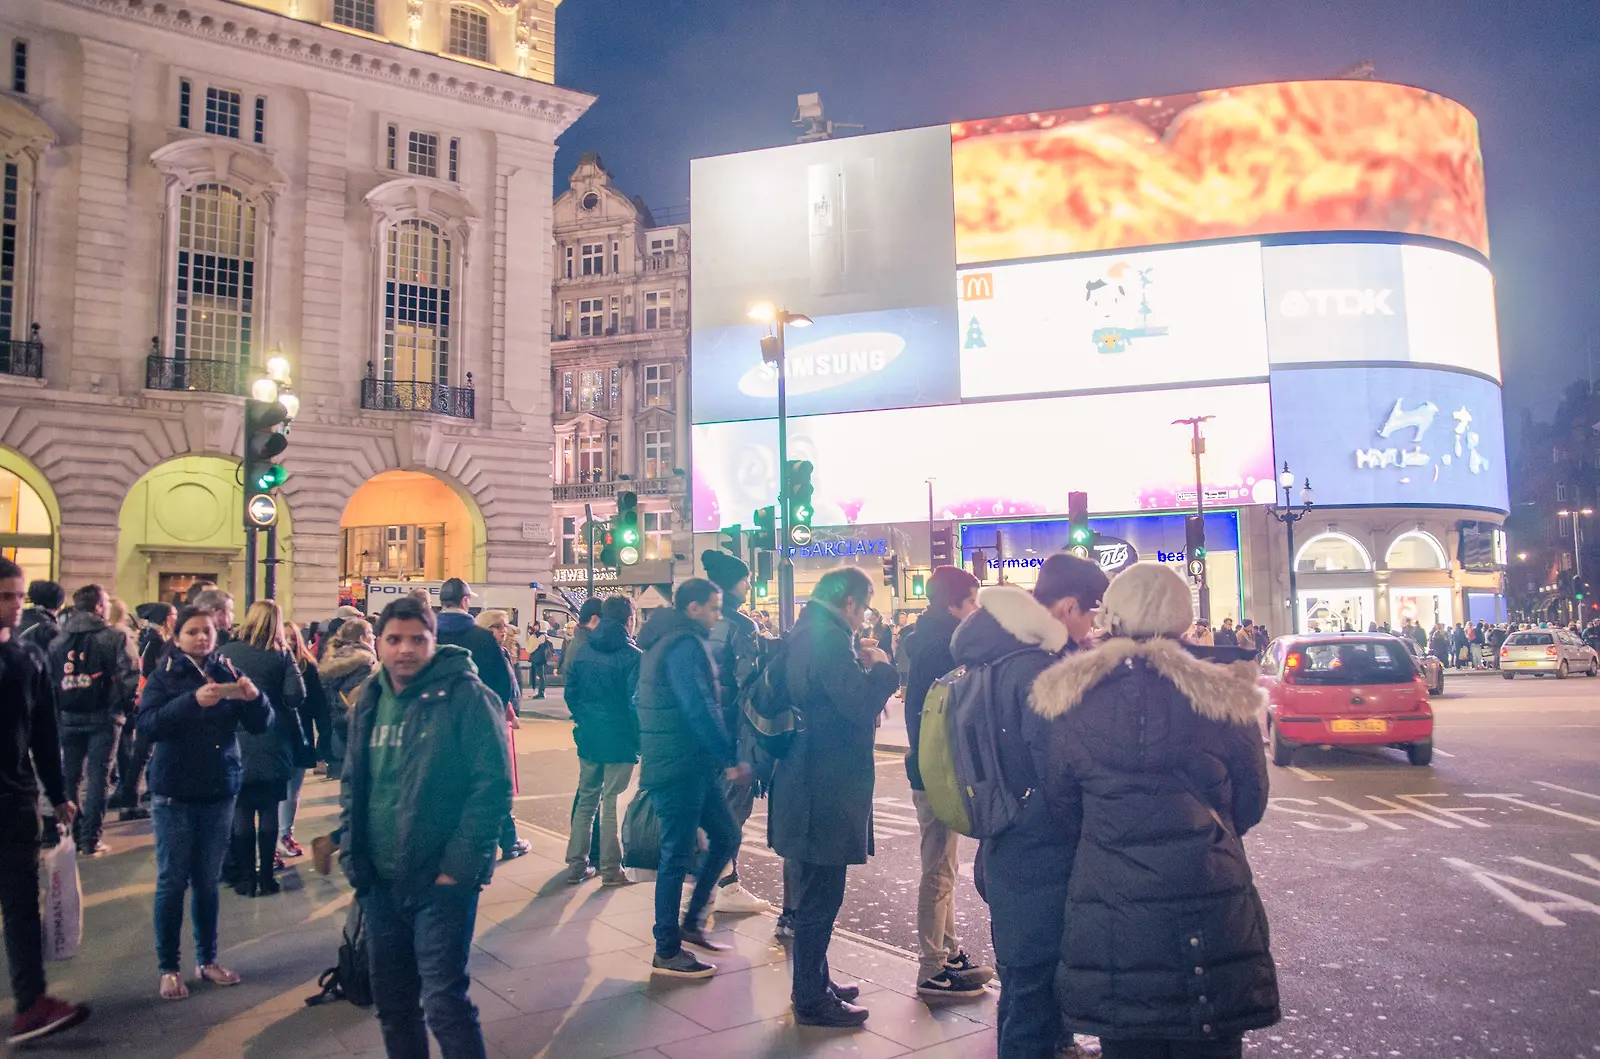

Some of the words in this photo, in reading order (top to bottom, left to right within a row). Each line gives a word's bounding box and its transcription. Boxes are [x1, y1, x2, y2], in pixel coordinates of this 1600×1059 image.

[1305, 288, 1396, 317] TDK
[759, 350, 886, 380] SAMSUNG
[800, 538, 887, 557] BARCLAYS
[1157, 550, 1185, 562] bea
[987, 558, 1044, 569] armacy
[1094, 543, 1128, 571] ots
[553, 568, 589, 582] JEWEL
[593, 567, 618, 580] BAR
[370, 586, 440, 594] POLE
